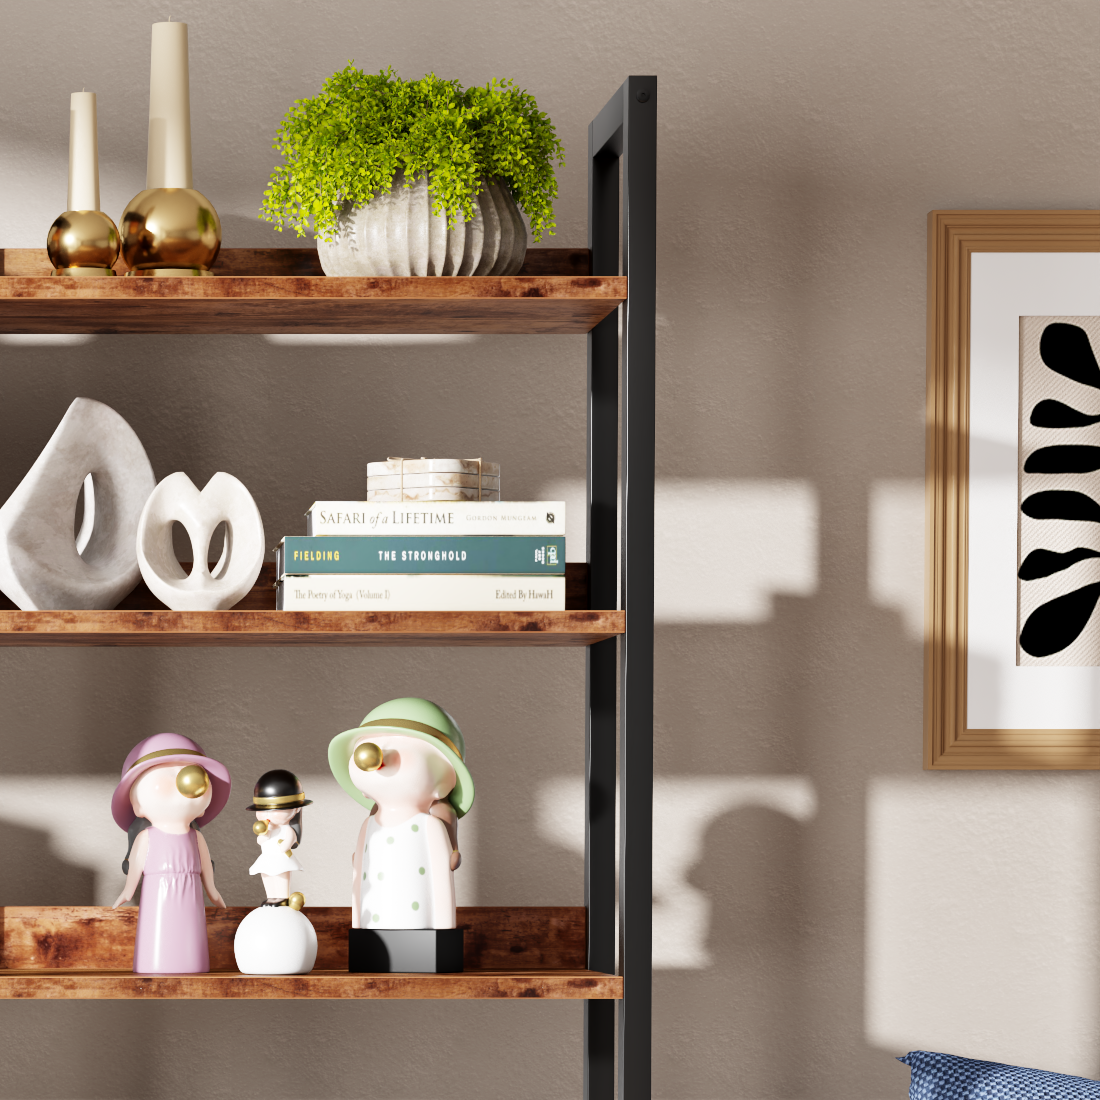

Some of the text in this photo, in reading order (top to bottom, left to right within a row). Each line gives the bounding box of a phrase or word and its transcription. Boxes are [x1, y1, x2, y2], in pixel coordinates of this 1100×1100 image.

[319, 511, 455, 529] SAFARI of a LIFETIME
[293, 550, 340, 561] FIELDING
[378, 550, 467, 561] THE STRONGHOLD
[294, 589, 306, 599] The
[307, 589, 328, 602] Poetry
[329, 589, 338, 599] of
[337, 589, 352, 602] Yoga
[356, 589, 383, 600] (Volume
[495, 589, 517, 599] Edited
[518, 589, 527, 602] By
